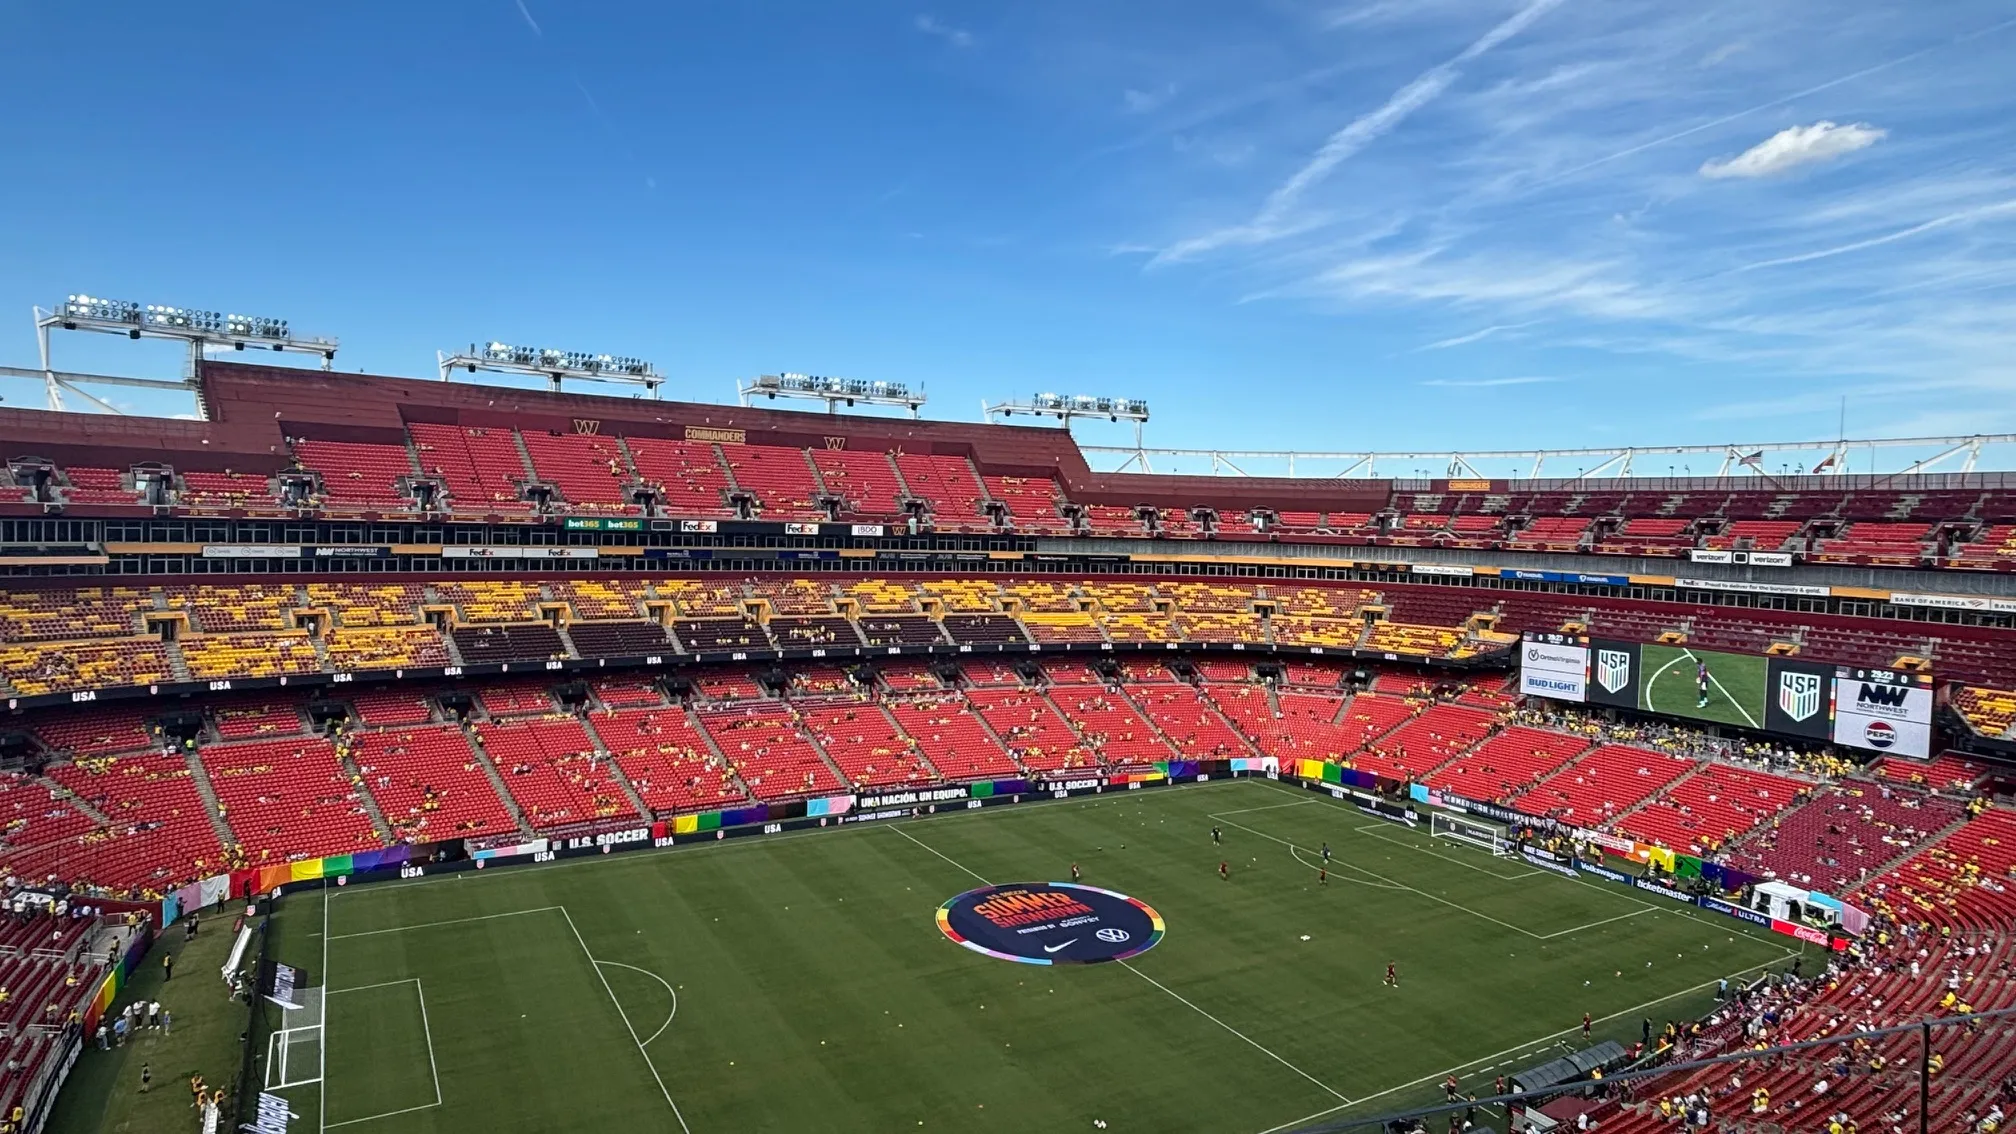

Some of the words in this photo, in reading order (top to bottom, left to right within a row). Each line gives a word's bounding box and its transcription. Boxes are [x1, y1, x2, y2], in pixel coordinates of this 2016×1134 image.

[685, 428, 746, 443] COMMANDERS
[568, 519, 600, 527] bet365
[608, 520, 639, 529] bet365
[683, 522, 712, 531] FedEx
[787, 524, 814, 533] FedEx
[1754, 556, 1787, 564] verizon
[1929, 599, 1966, 607] AMERICA
[732, 652, 747, 660] USA
[1310, 647, 1323, 655] USA
[647, 656, 662, 665] USA
[1540, 653, 1581, 664] OrthoVirginia
[1601, 652, 1627, 669] USA
[444, 666, 462, 676] USA
[546, 661, 563, 670] USA
[333, 673, 353, 683] USA
[209, 681, 231, 691] USA
[1528, 678, 1548, 688] BUD
[1549, 680, 1577, 692] LIGHT
[1783, 674, 1818, 694] USA
[72, 691, 96, 702] USA
[1858, 683, 1910, 707] NW
[1856, 702, 1909, 714] NORTHWEST
[1866, 731, 1895, 740] PEPSI
[1049, 781, 1065, 792] U.S.
[1065, 779, 1098, 790] SOCCER
[1129, 781, 1141, 790] USA
[860, 795, 880, 808] UNA
[919, 791, 933, 801] UN
[933, 788, 967, 800] EQUIPO.
[1054, 789, 1068, 798] USA
[1331, 789, 1344, 799] USA
[967, 800, 982, 808] USA
[1405, 810, 1418, 821] USA
[764, 823, 782, 833] USA
[569, 836, 594, 848] U.S.
[596, 828, 648, 846] SOCCER
[655, 836, 674, 847] USA
[534, 851, 555, 862] USA
[401, 866, 424, 878] USA
[1580, 861, 1625, 882] Volkswagen
[1637, 879, 1692, 902] ticketmaster
[973, 892, 1079, 919] SUMMER
[991, 903, 1095, 928] SHOWDOWN
[1738, 910, 1766, 925] ULTRA
[1793, 927, 1828, 947] Coca-Cola
